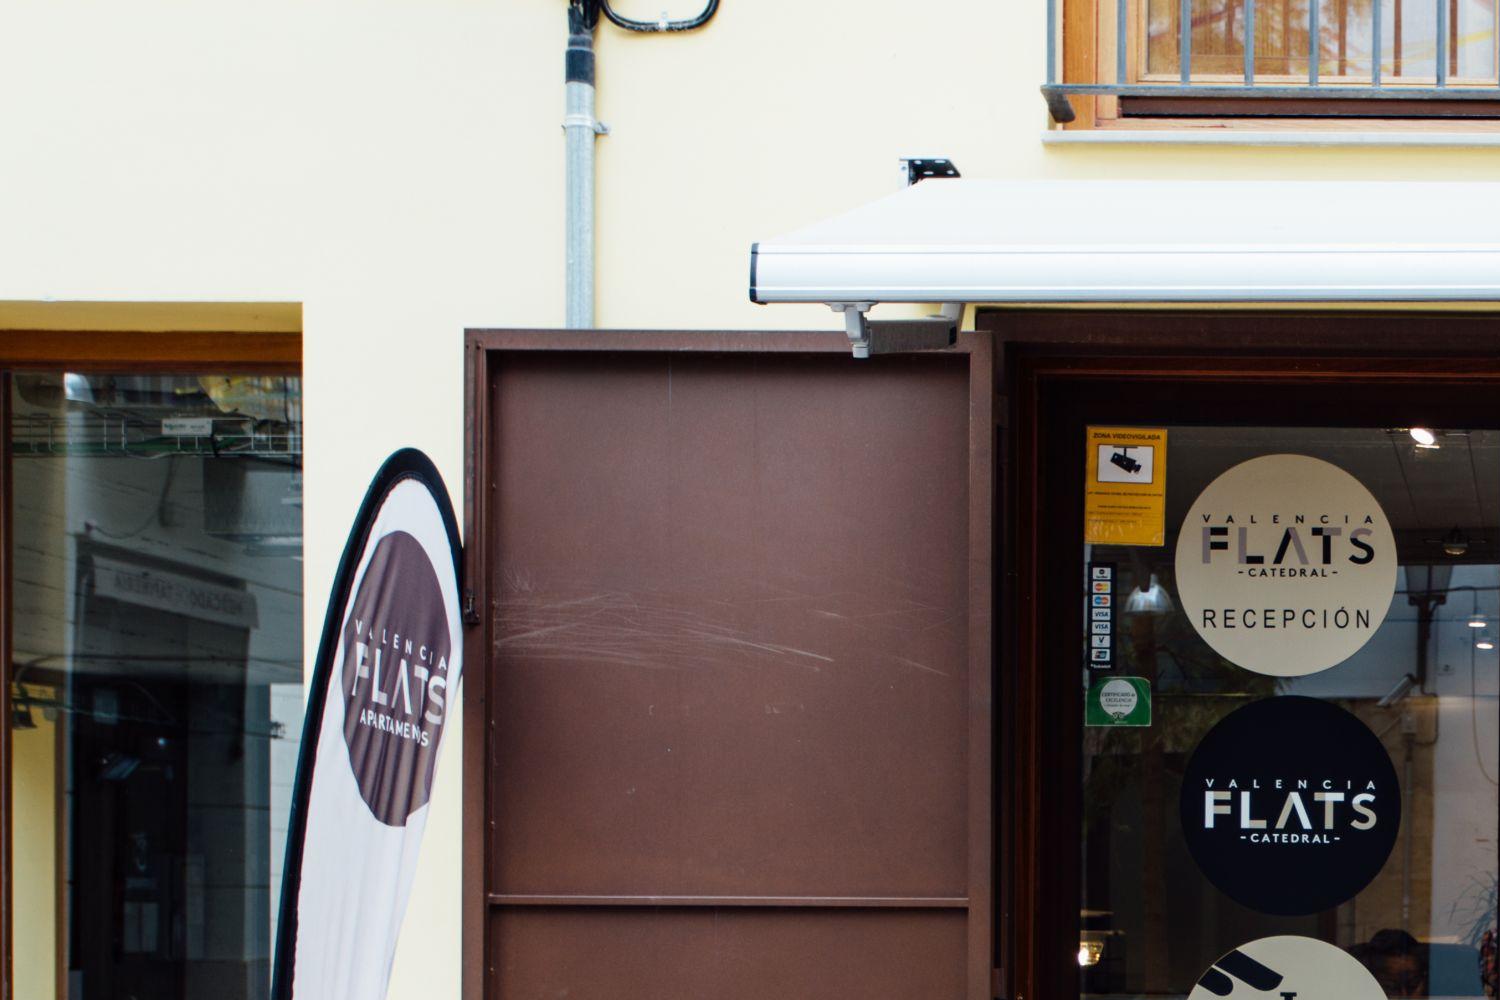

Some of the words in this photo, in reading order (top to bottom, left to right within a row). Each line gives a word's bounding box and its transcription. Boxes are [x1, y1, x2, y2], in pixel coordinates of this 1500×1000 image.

[1112, 432, 1161, 441] VIDEOVIGILADA
[1202, 514, 1374, 524] VALENCIA
[1202, 527, 1375, 564] FLATS
[1203, 606, 1370, 629] RECEPCIÓN
[351, 641, 447, 725] FLATS
[1205, 778, 1376, 790] VALENCIA
[1204, 790, 1377, 830] FLATS
